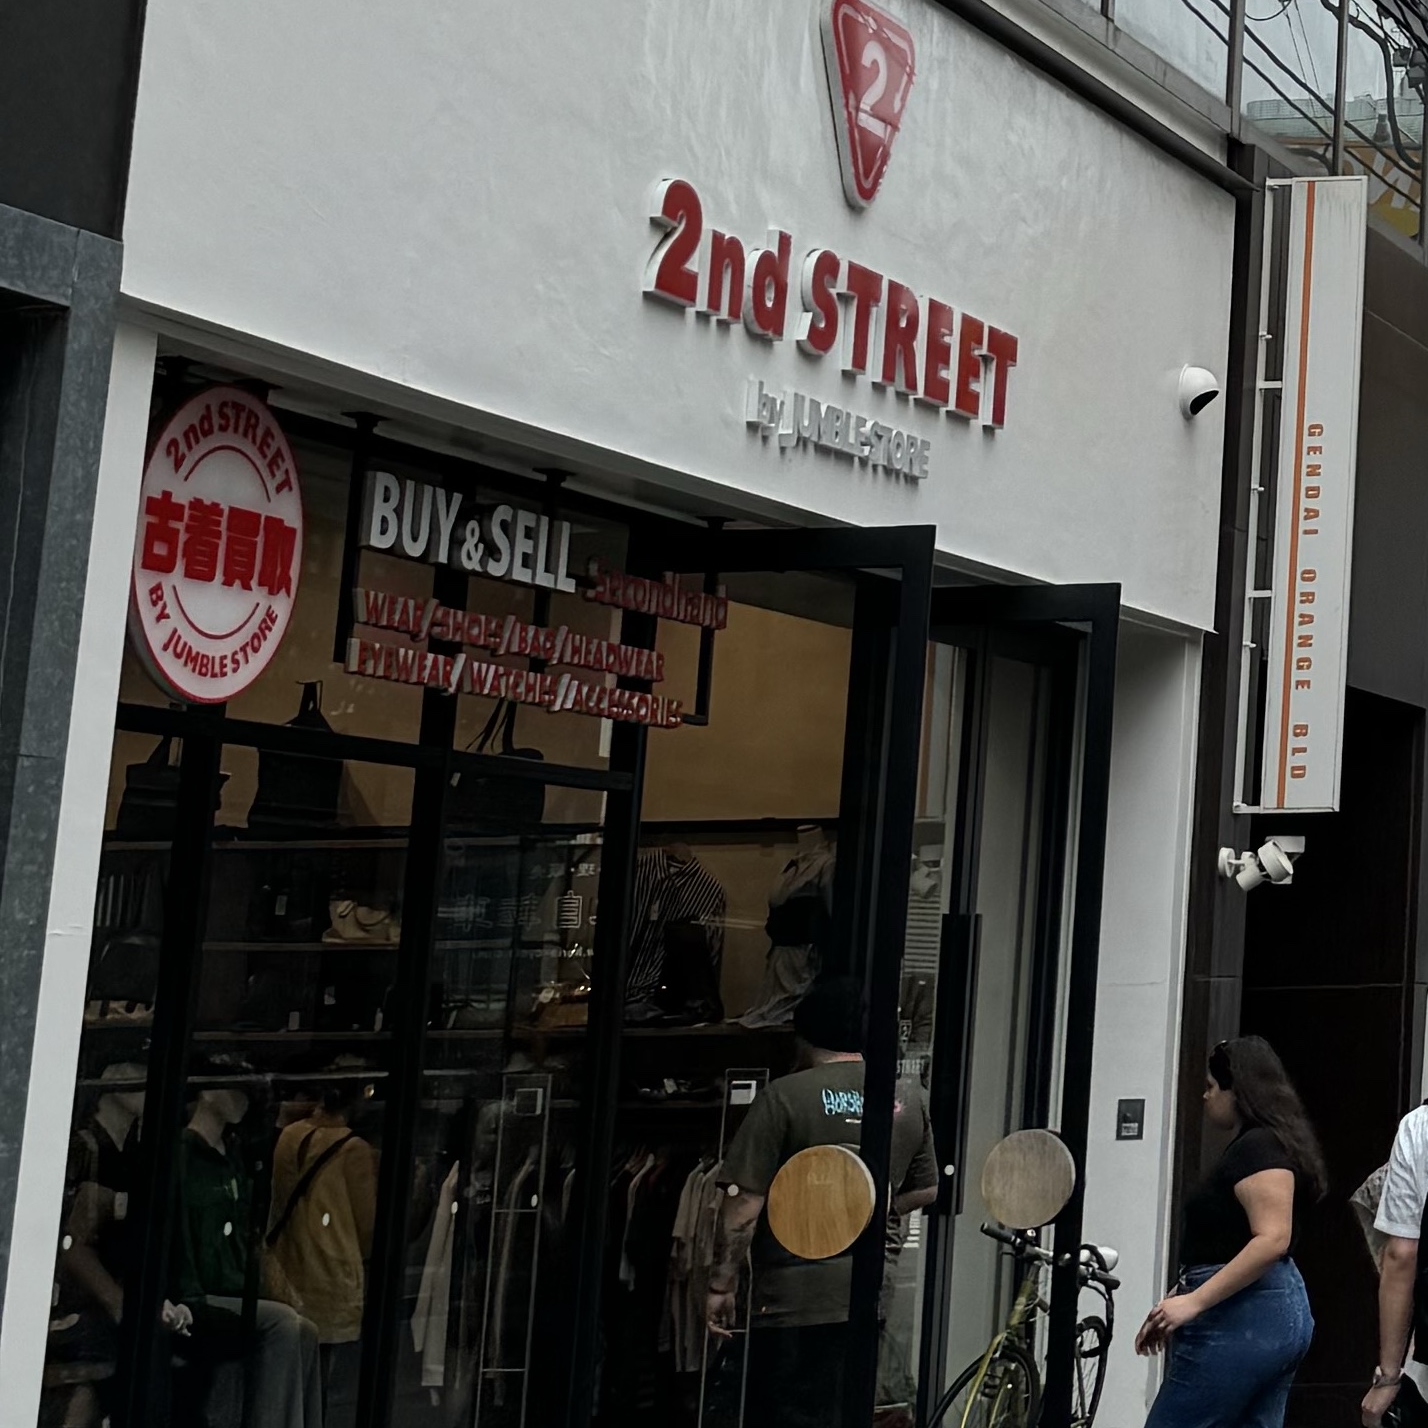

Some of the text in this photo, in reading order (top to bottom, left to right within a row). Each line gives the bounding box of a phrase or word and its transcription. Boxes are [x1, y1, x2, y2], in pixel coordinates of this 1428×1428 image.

[645, 178, 1018, 429] 2nd STREET
[166, 400, 294, 495] 2nd STREET
[141, 489, 298, 599] 古着買取
[149, 581, 279, 679] BY JUMBLE STORE
[1290, 422, 1324, 780] GENDAI ORANGE BLD
